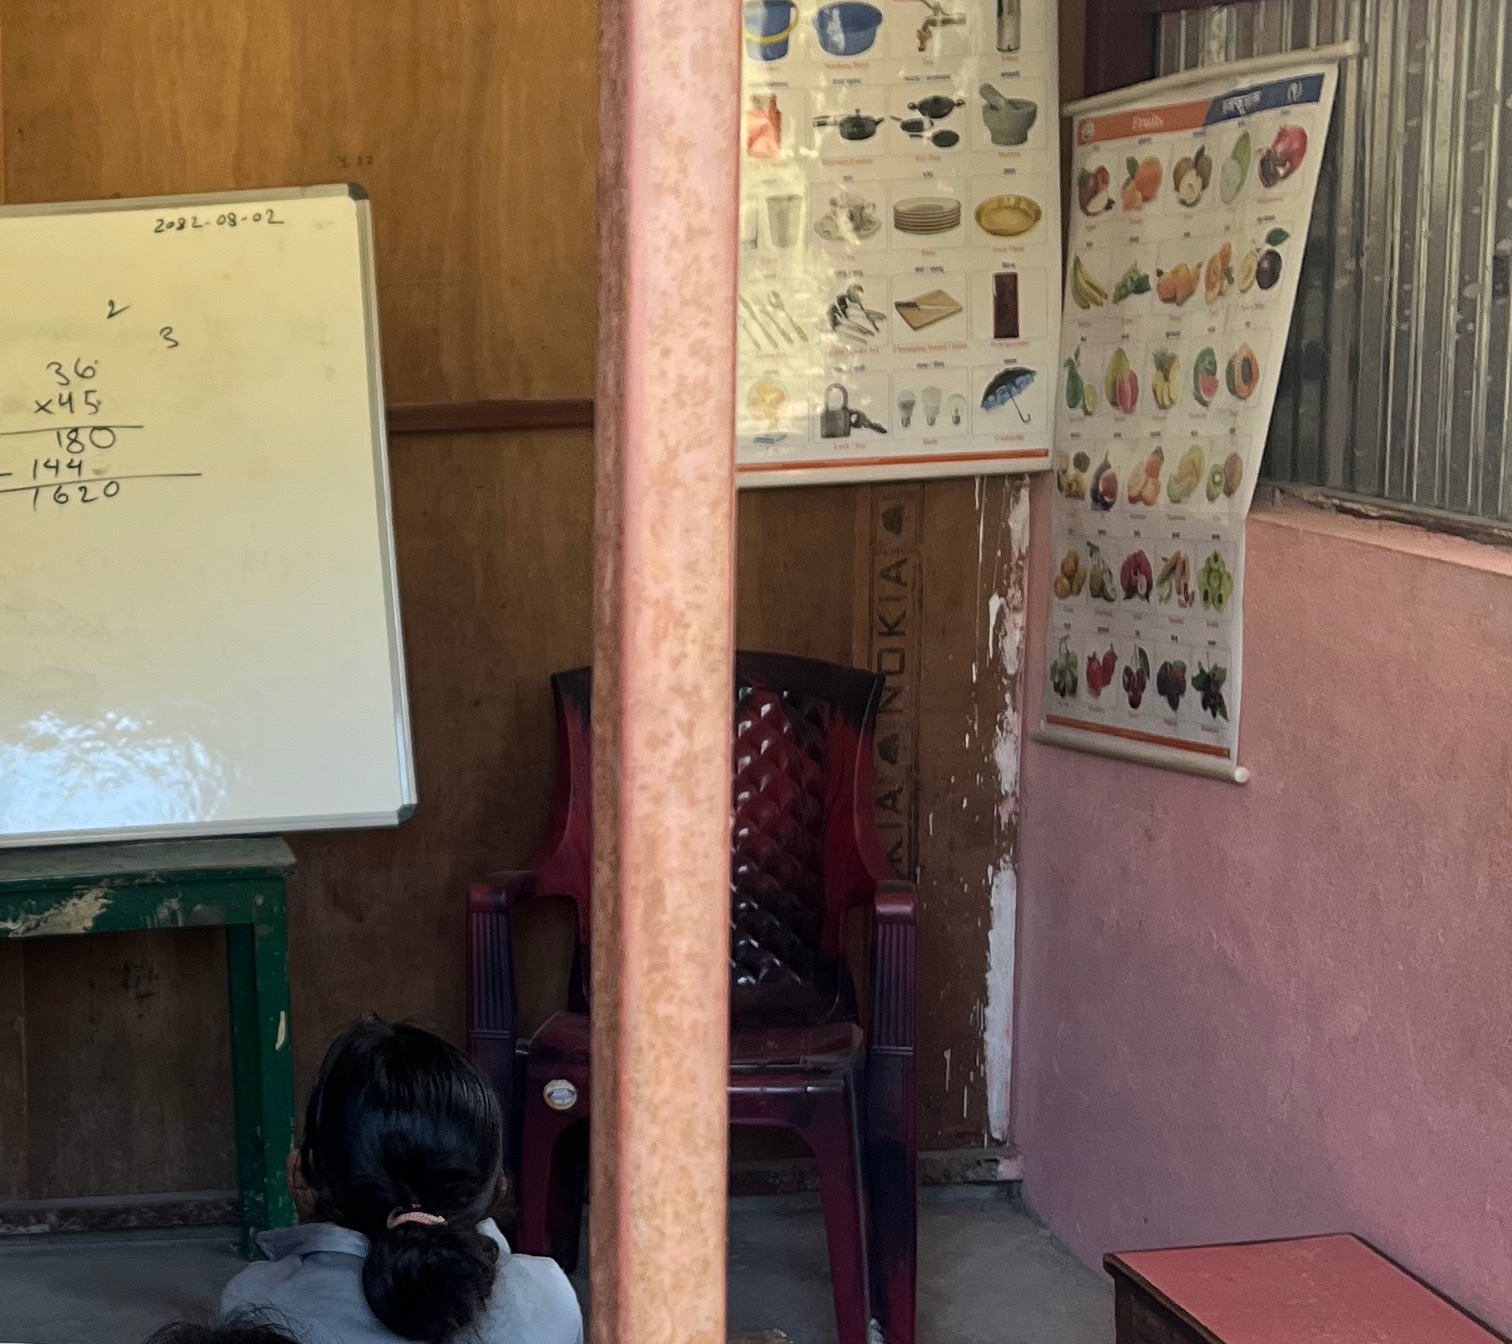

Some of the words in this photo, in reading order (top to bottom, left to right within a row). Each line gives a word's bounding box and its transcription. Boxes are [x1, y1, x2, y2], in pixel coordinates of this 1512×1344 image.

[106, 299, 132, 319] 2
[158, 326, 180, 349] 3
[57, 427, 116, 454] 180
[32, 481, 121, 513] 1620
